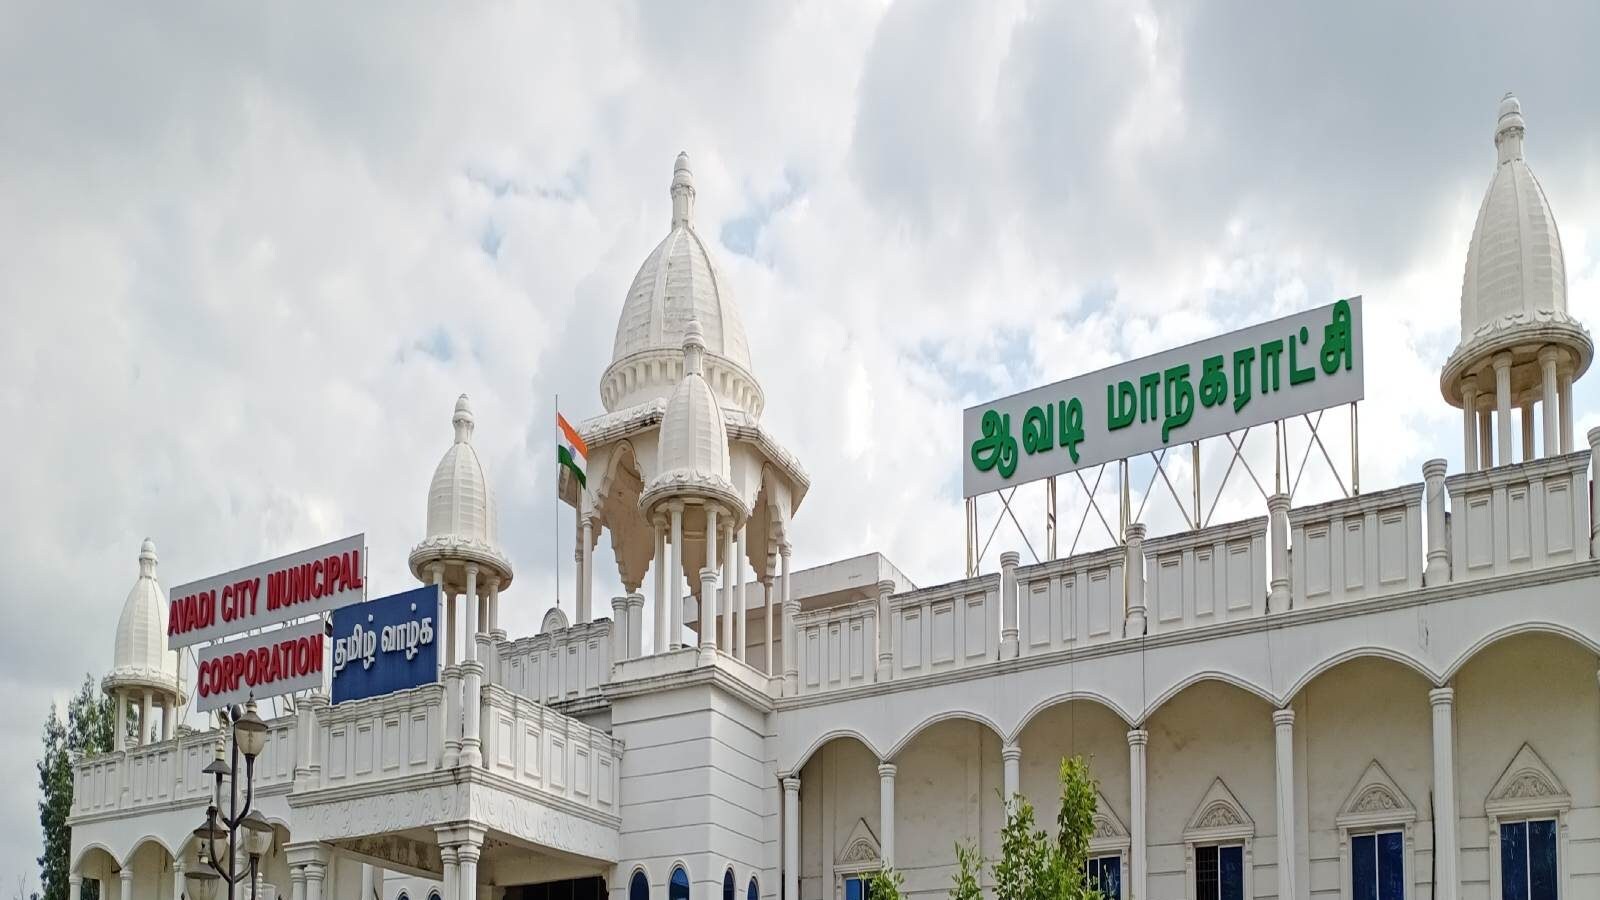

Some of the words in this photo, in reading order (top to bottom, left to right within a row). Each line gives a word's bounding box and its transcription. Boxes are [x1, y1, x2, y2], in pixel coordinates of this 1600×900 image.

[971, 397, 1084, 479] ஆவடி
[1107, 299, 1352, 443] மாநகராட்சி
[168, 589, 216, 636] AVADI
[221, 578, 260, 622] CITY
[266, 550, 363, 612] MUNICIPAL
[198, 633, 324, 698] CORPORATION
[333, 613, 377, 678] தமிழ்
[381, 602, 433, 661] வாழ்க
